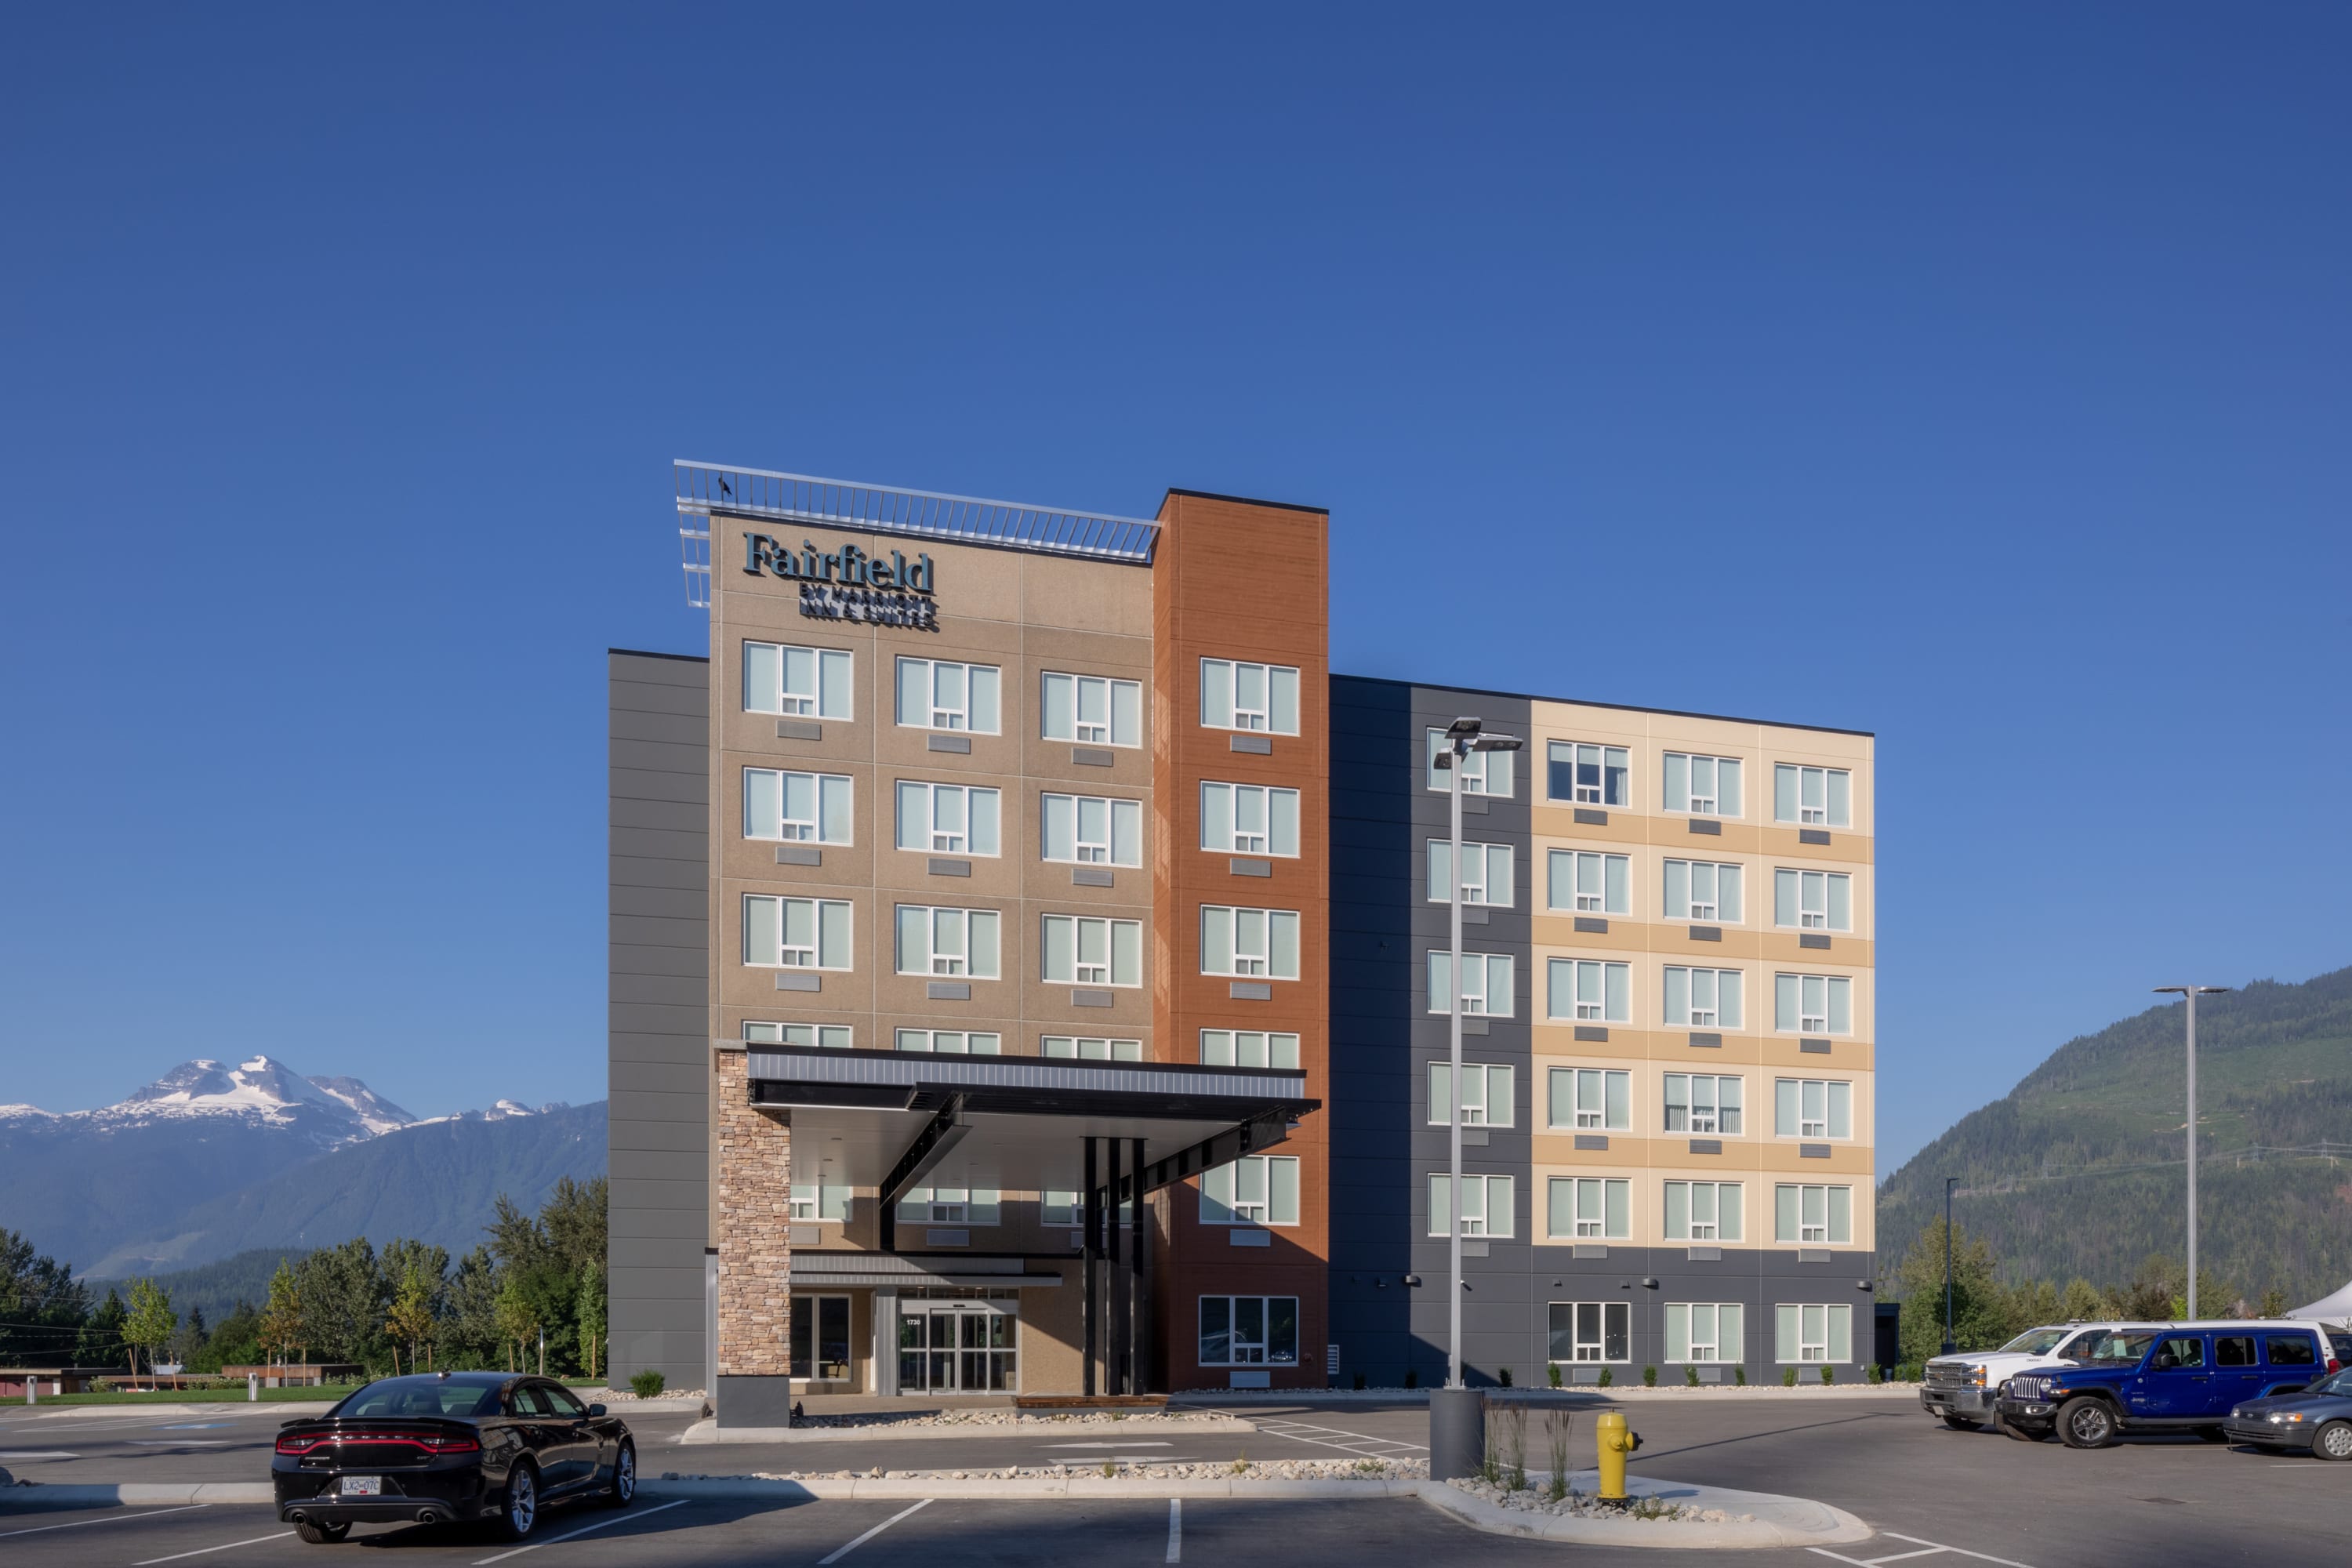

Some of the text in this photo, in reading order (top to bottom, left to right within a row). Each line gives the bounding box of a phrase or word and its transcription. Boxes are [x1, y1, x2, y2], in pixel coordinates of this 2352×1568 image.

[743, 532, 931, 590] Fairfield
[800, 583, 931, 610] BY MARRIOTT
[800, 598, 933, 626] INN & SUITES
